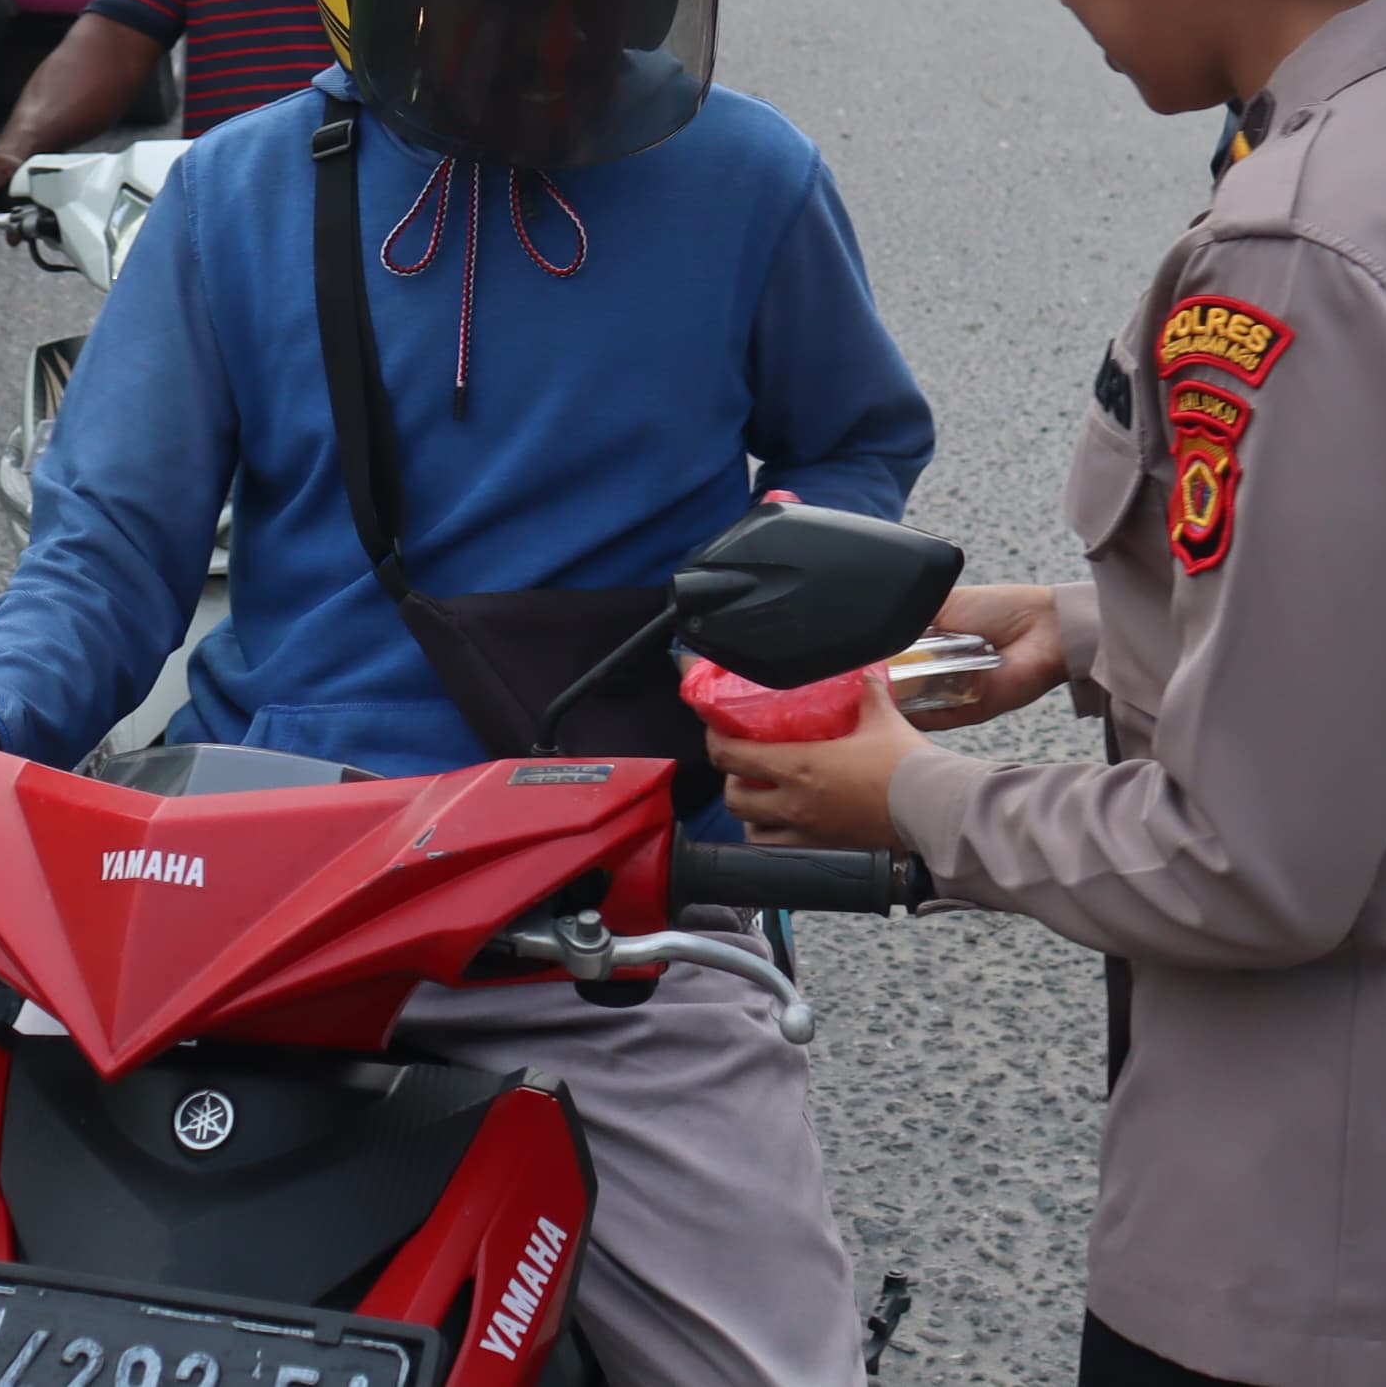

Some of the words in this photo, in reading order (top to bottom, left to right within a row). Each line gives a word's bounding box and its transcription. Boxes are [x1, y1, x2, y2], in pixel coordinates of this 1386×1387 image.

[1163, 305, 1273, 353] POLRES
[101, 849, 205, 888] YAMAHA
[479, 1216, 568, 1361] YAMAHA
